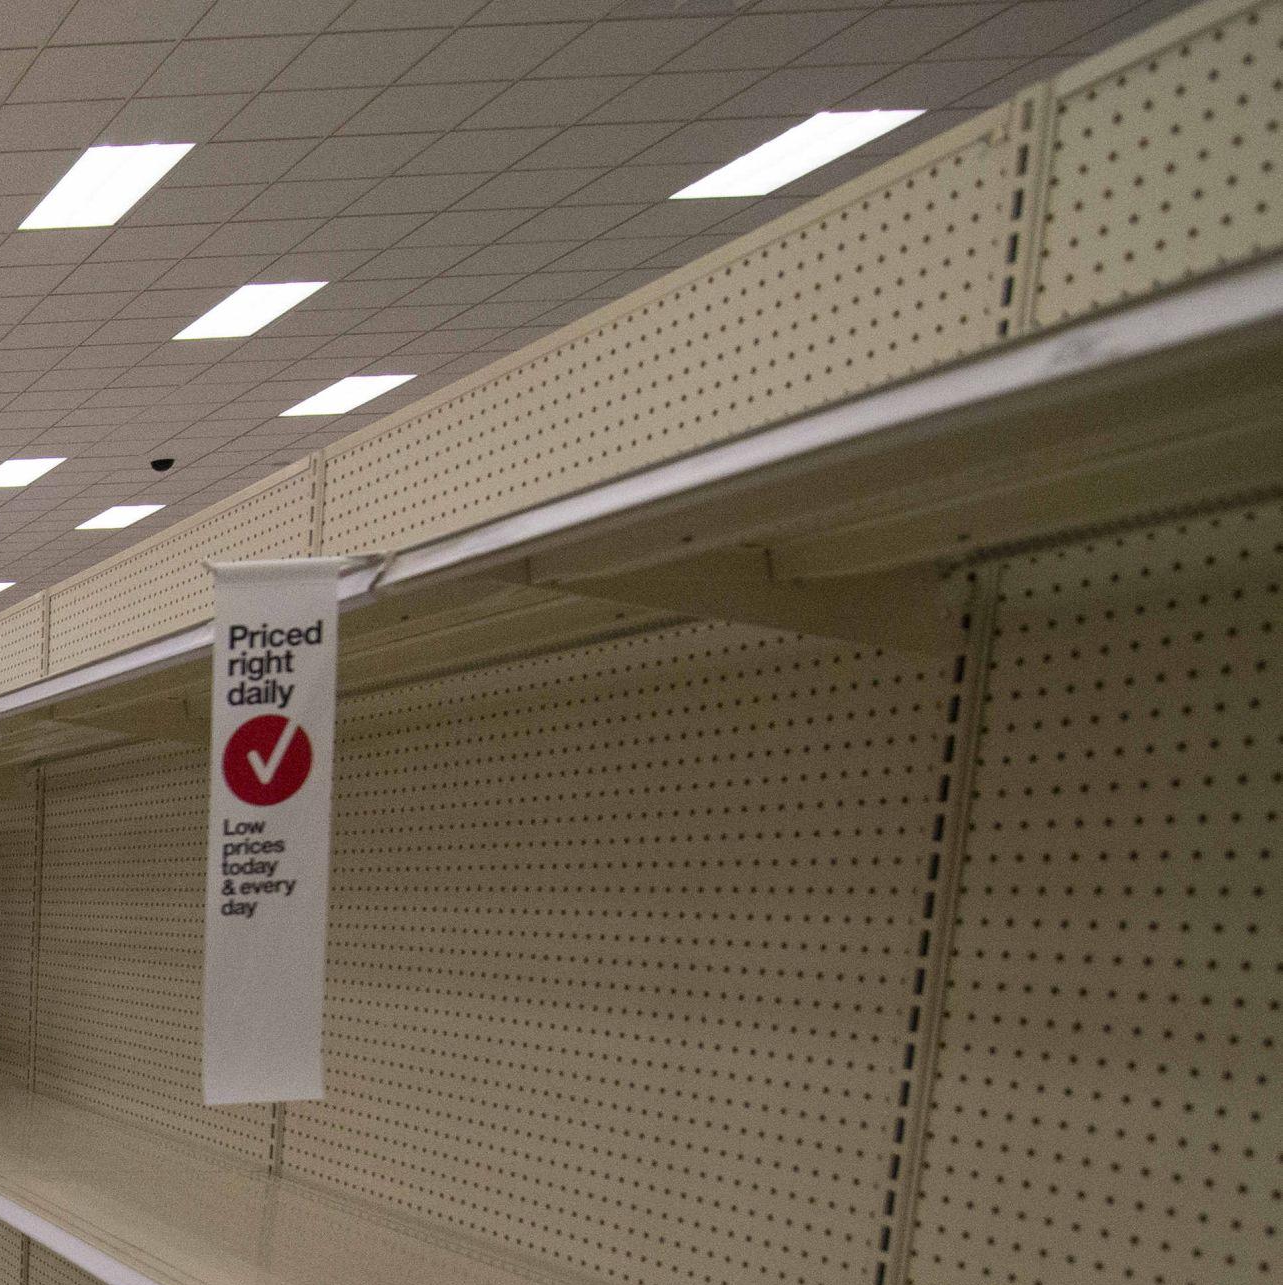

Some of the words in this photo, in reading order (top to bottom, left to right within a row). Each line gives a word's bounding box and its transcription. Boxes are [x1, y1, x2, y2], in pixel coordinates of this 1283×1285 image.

[229, 619, 323, 650] Priced
[228, 650, 294, 681] right
[227, 679, 295, 709] daily
[223, 818, 265, 836] Low
[222, 838, 285, 860] prices
[222, 858, 280, 877] today
[221, 879, 236, 896] &
[239, 880, 297, 896] every
[221, 899, 258, 918] day
